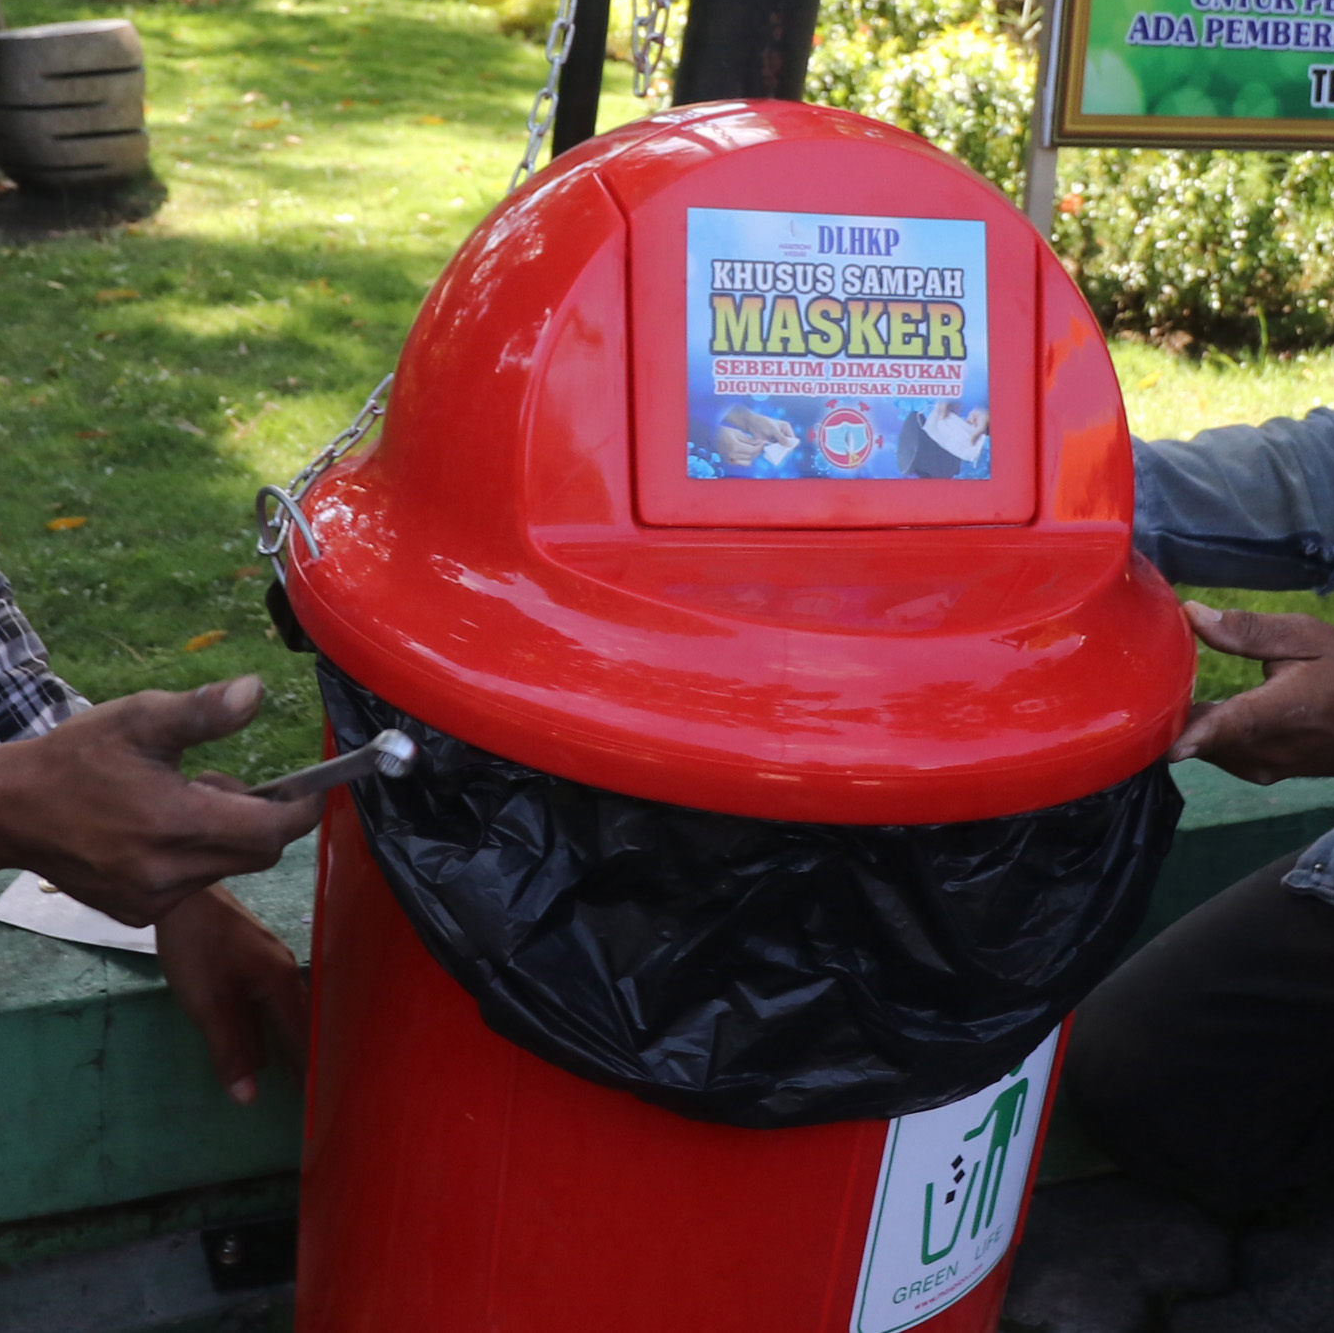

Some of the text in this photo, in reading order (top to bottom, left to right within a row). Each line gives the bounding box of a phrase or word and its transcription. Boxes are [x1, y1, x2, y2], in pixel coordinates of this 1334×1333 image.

[1128, 13, 1197, 45] ADA
[818, 226, 899, 256] DLHKP
[712, 261, 963, 298] KHUSUS SAMPAH
[711, 294, 966, 359] MASKER
[715, 360, 961, 380] SEBELUM DIMASUKAN
[716, 380, 960, 396] DIGUNTING/DIRUSAK DAHULU
[892, 1261, 959, 1305] GREEN
[974, 1223, 1003, 1261] LIFE
